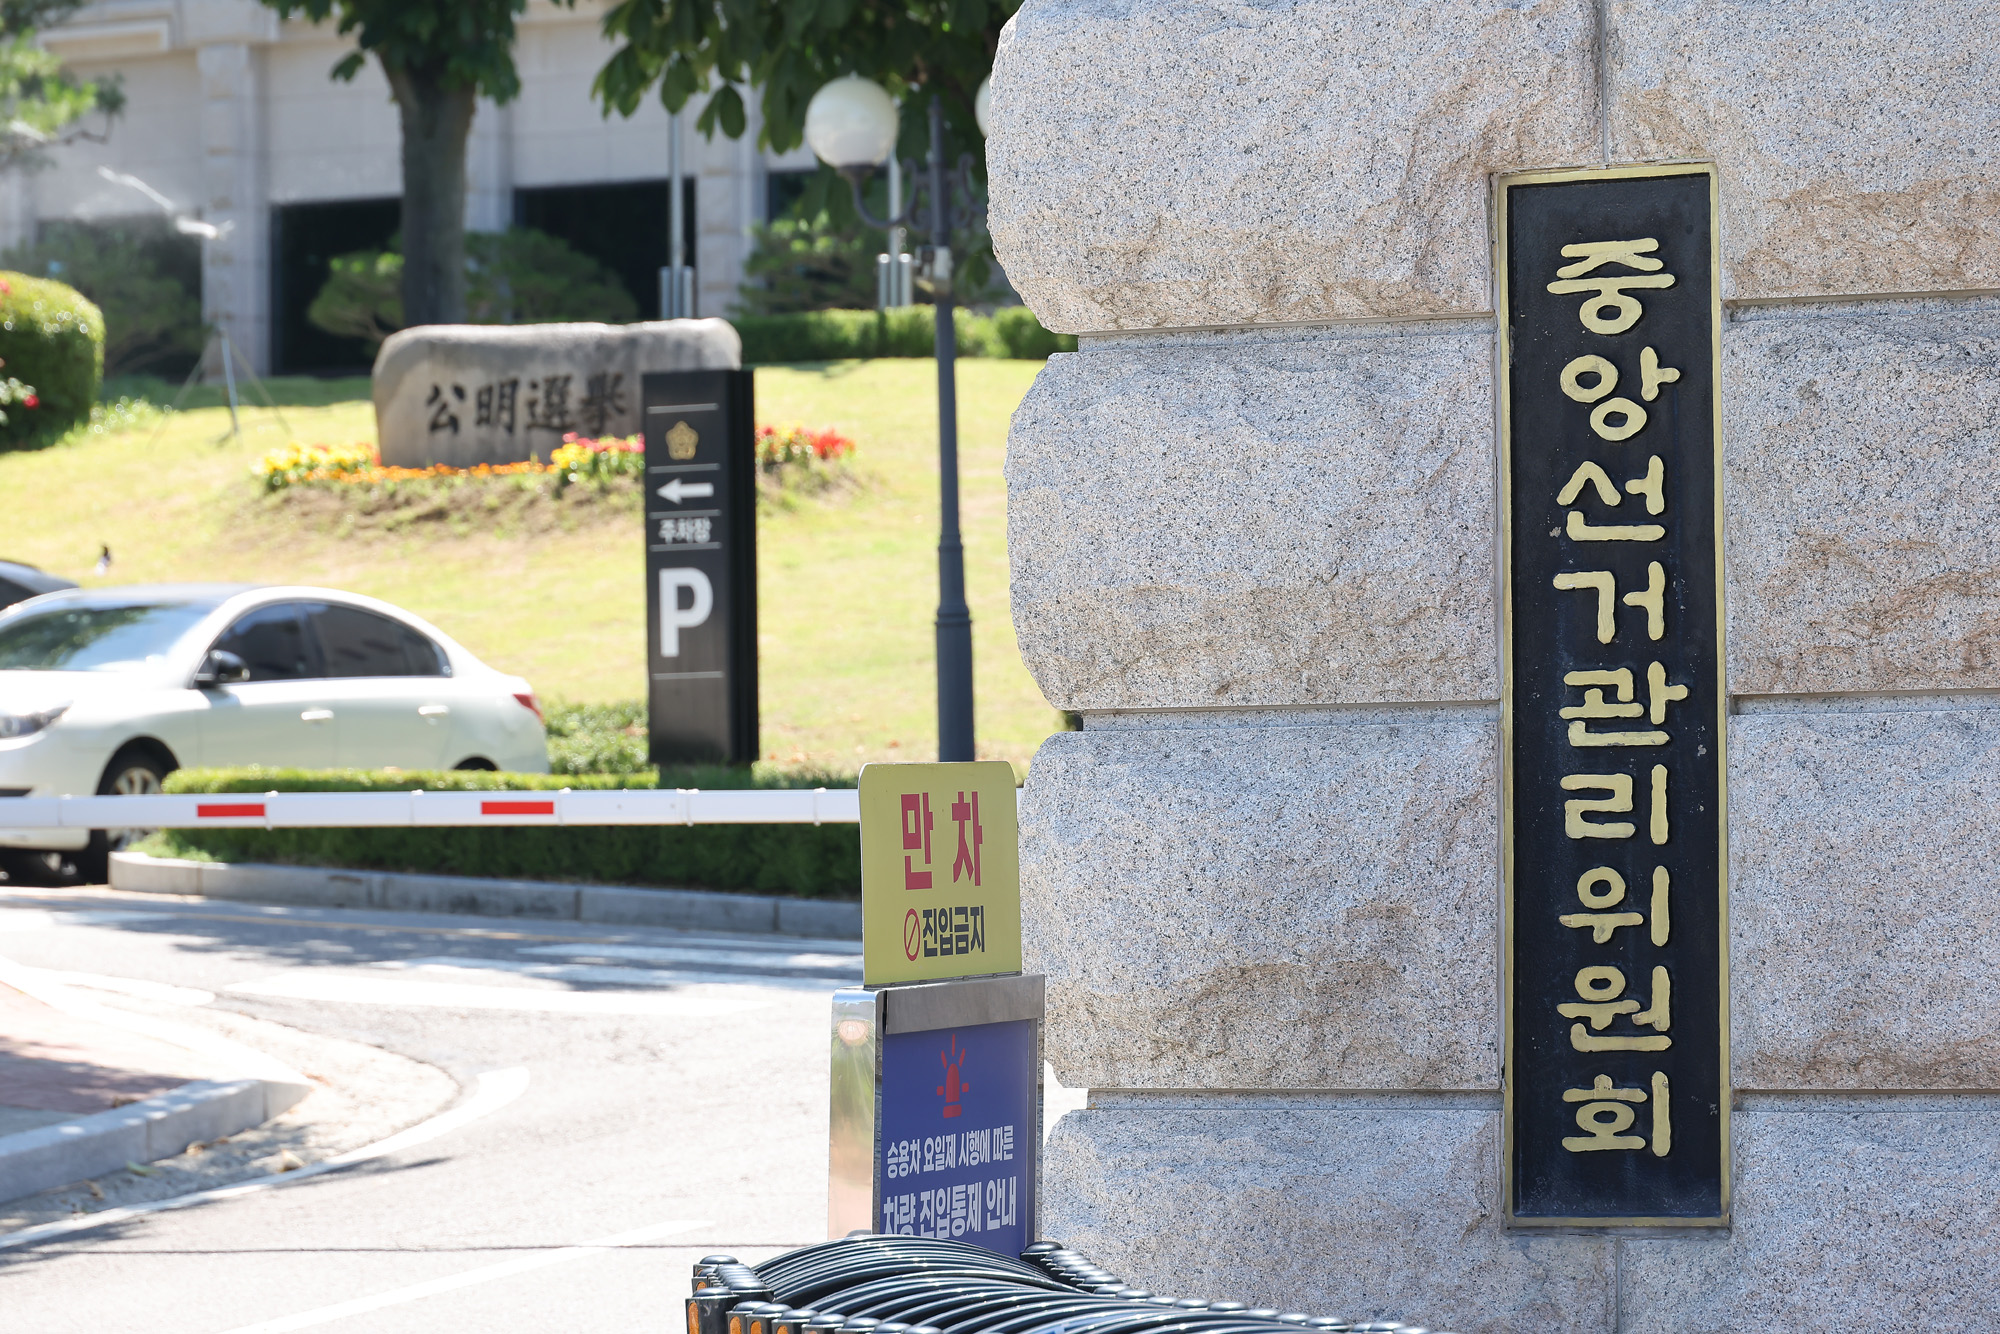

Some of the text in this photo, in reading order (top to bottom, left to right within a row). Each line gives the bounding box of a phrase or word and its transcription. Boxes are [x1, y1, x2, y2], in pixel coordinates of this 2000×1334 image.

[658, 516, 713, 544] 주차장
[658, 567, 714, 658] P
[1546, 237, 1689, 1157] 중앙선거관리위원회
[922, 905, 985, 957] 진입금지
[887, 1125, 1014, 1179] 승용차 요일제 시행에 따른
[883, 1176, 1017, 1239] 차량 진입통제 안내
